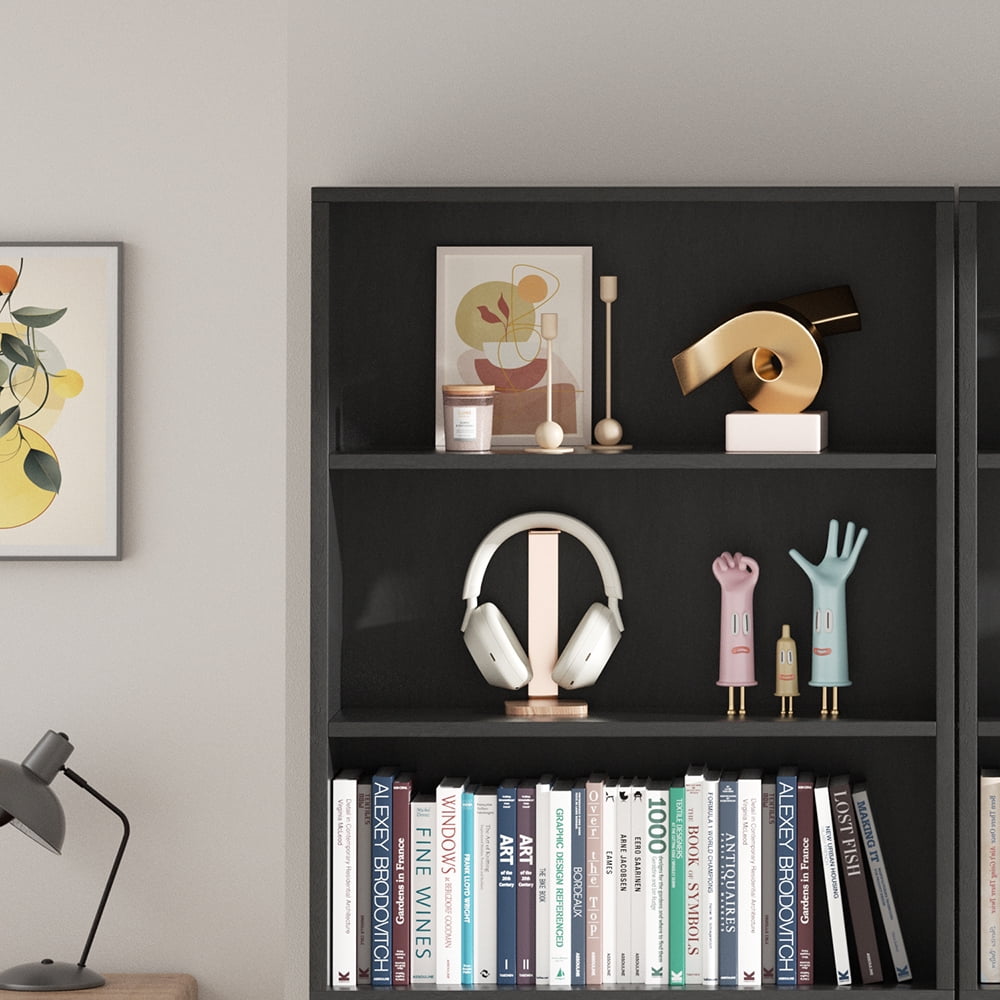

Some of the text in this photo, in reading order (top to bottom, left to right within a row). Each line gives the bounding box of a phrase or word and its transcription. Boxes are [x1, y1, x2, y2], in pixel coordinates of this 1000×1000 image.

[373, 782, 389, 851] ALEXEY
[416, 827, 432, 876] FINE
[441, 795, 456, 874] WINDOWS
[500, 834, 513, 865] ART
[519, 834, 532, 865] ART
[648, 798, 667, 854] 1000
[688, 826, 699, 866] BOOK
[834, 790, 861, 877] LOST FISH
[857, 801, 879, 862] MAKING IT
[396, 838, 405, 925] Gardens in France
[555, 808, 564, 948] GRAPHIC DESIGN REFERENCED
[573, 867, 582, 917] BORDEAUX
[724, 832, 736, 933] ANTIQUAIRES
[779, 781, 795, 971] ALEXEY BRODOVITCH
[824, 826, 839, 899] NEW URBAN HOUSING
[373, 857, 389, 971] BRODOVITCH
[416, 886, 432, 959] WINES
[444, 882, 452, 914] BERGDORF
[444, 916, 452, 948] GOODMAN
[688, 883, 699, 955] SYMBOLS
